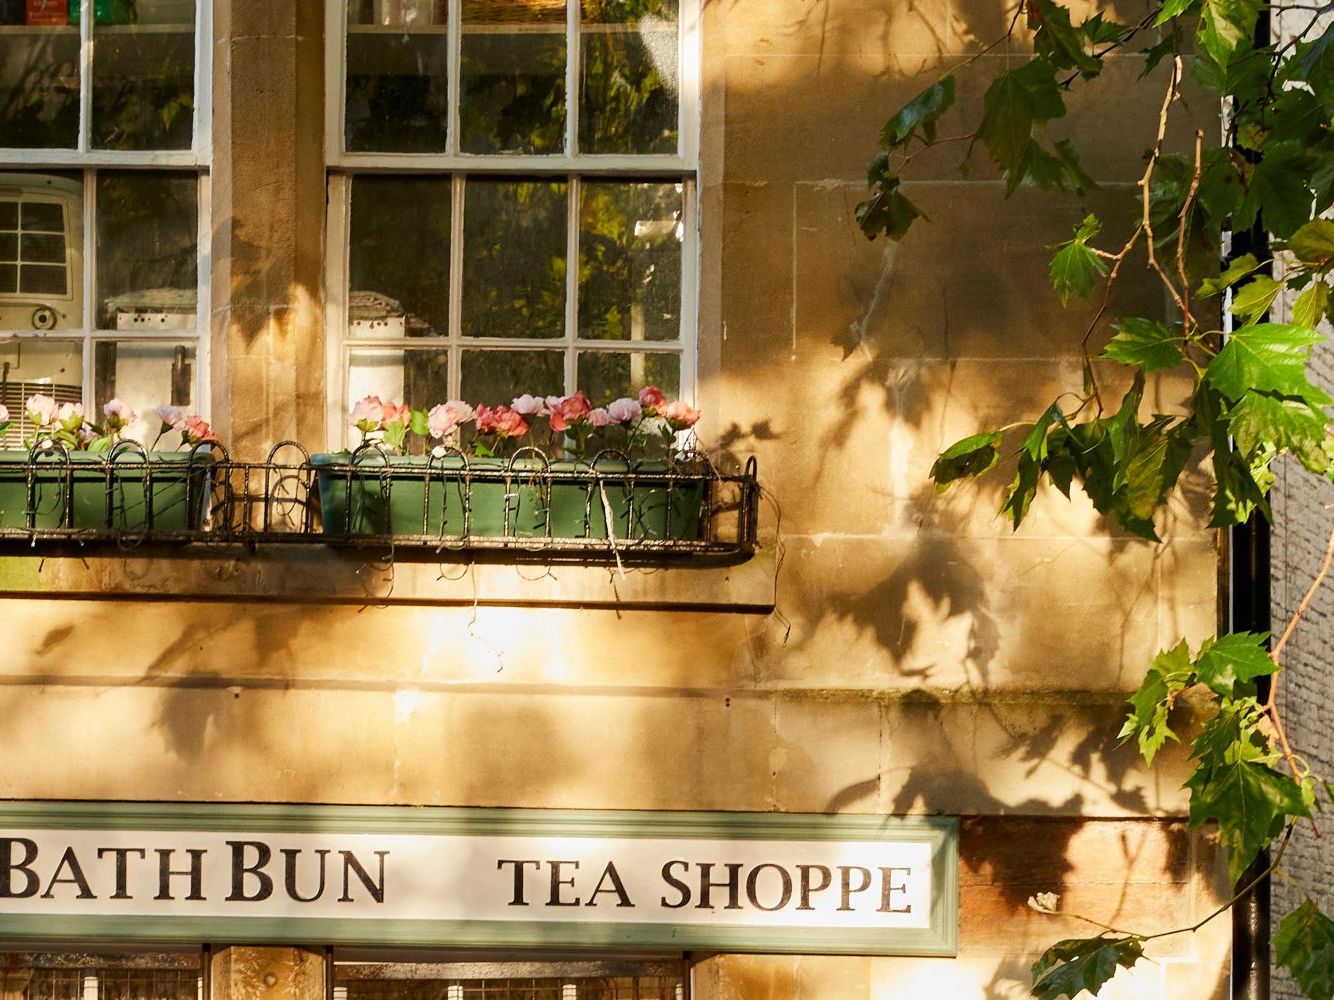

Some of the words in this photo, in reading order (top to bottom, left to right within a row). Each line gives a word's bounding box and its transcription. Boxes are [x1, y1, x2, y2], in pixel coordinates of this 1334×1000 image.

[224, 840, 390, 903] BUN
[497, 859, 635, 907] TEA
[661, 860, 912, 913] SHOPPE
